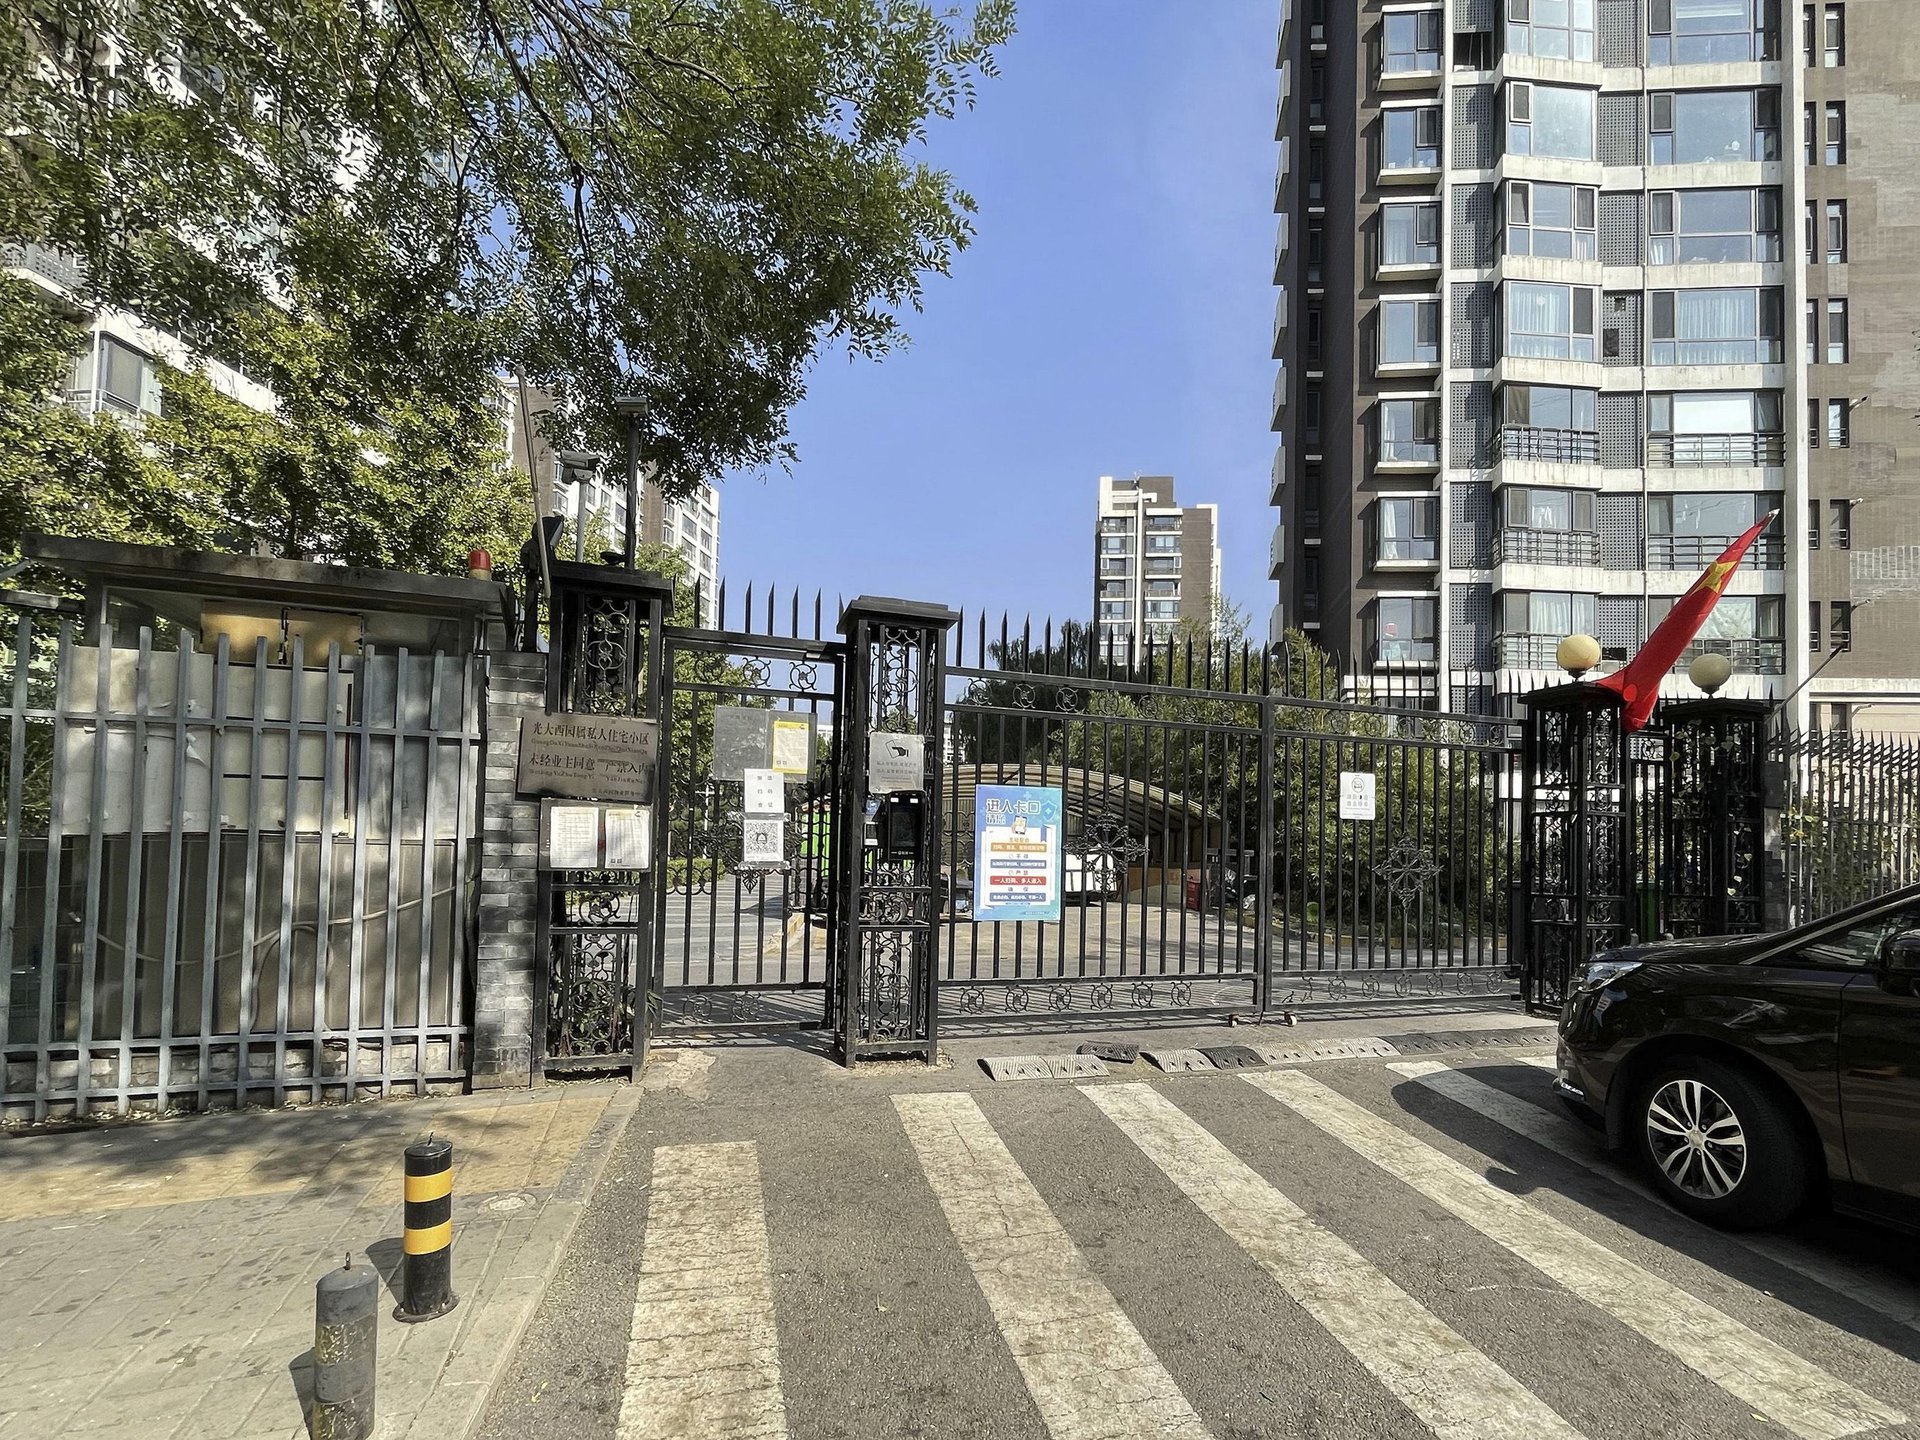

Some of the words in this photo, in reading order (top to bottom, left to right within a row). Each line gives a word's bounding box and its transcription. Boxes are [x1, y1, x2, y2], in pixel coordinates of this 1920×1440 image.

[532, 721, 649, 745] 光大西园属私人住宅小区
